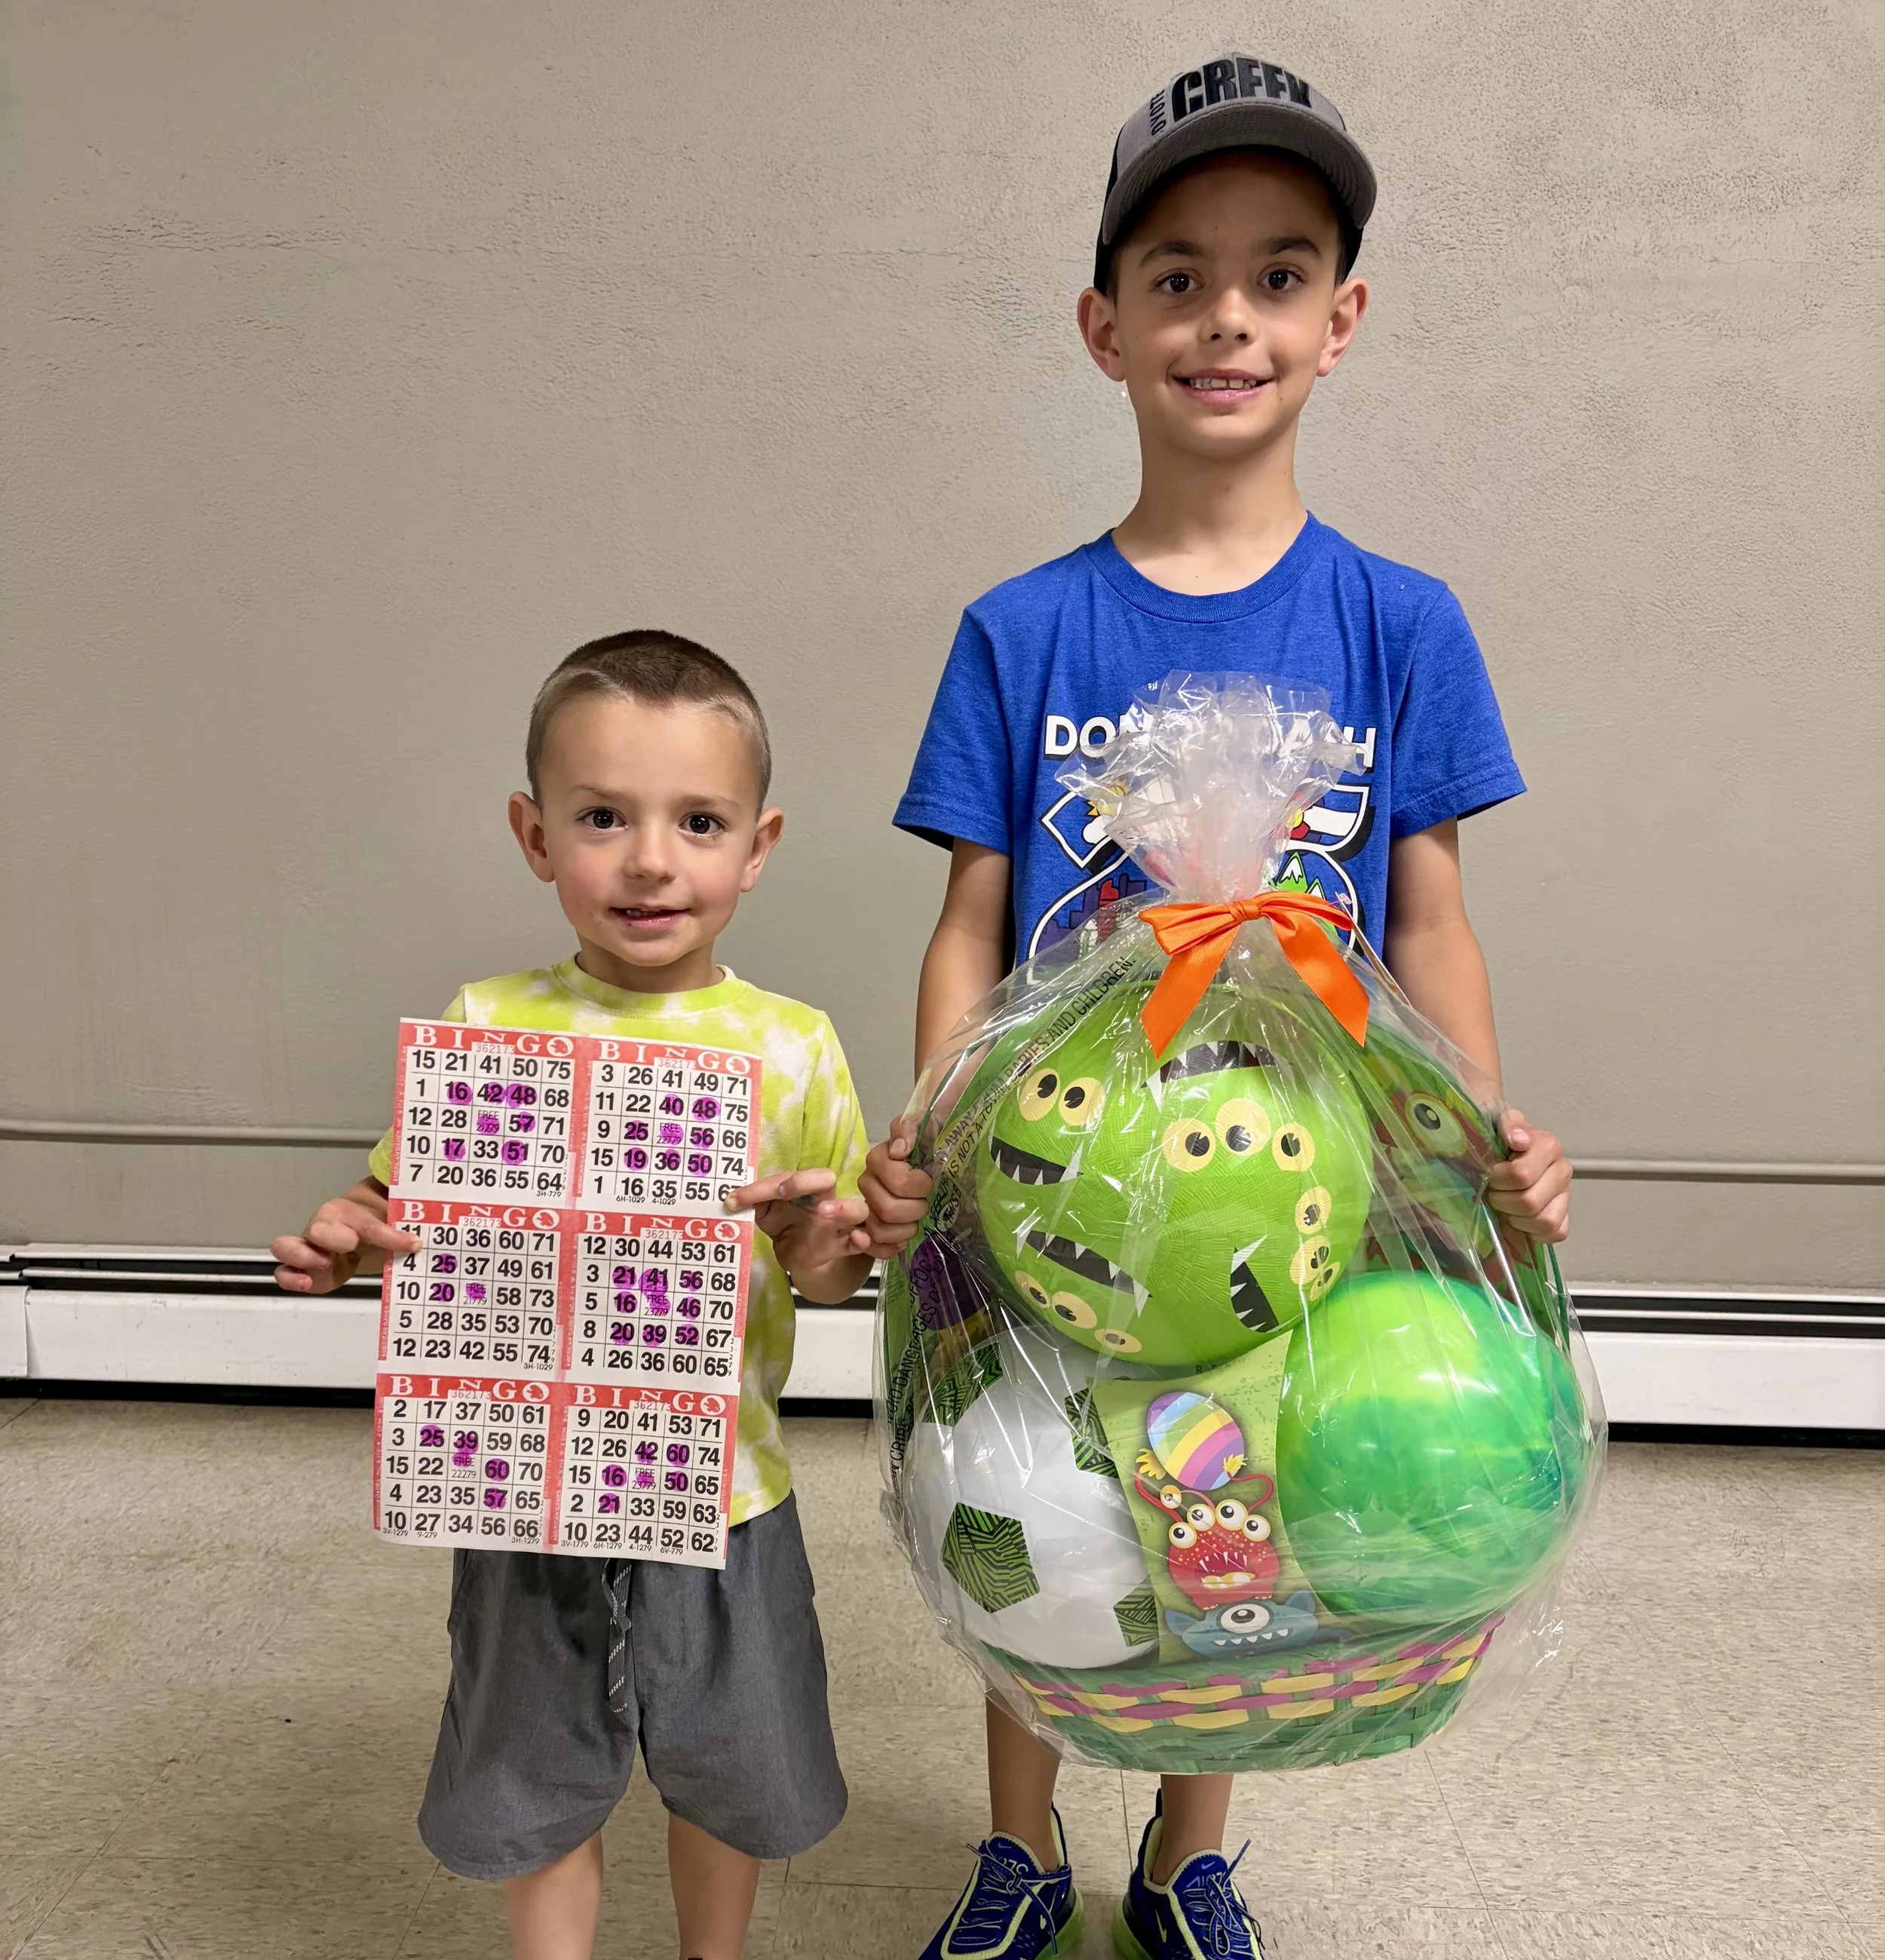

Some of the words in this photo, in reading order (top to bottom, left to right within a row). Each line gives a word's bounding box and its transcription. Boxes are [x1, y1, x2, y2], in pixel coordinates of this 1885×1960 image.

[1047, 1012, 1076, 1042] AND
[413, 1025, 574, 1056] BINGO
[413, 1050, 435, 1069] 15
[446, 1052, 467, 1071] 21
[480, 1055, 501, 1073] 41
[513, 1058, 537, 1076] 50
[547, 1061, 570, 1079] 75
[599, 1040, 750, 1075] BINGO
[417, 1079, 425, 1096] 1
[446, 1082, 467, 1100] 16
[477, 1084, 502, 1102] 42
[511, 1086, 536, 1104] 48
[544, 1089, 569, 1107] 68
[602, 1064, 613, 1082] 3
[628, 1067, 652, 1085] 26
[662, 1070, 682, 1088] 41
[694, 1073, 718, 1092] 49
[726, 1076, 747, 1096] 71
[477, 1110, 499, 1121] FREE
[596, 1092, 614, 1110] 11
[626, 1095, 651, 1113] 22
[659, 1098, 683, 1116] 40
[692, 1100, 715, 1117] 48
[725, 1103, 748, 1122] 75
[409, 1107, 431, 1125] 12
[441, 1110, 467, 1128] 28
[509, 1114, 535, 1132] 57
[543, 1117, 564, 1135] 71
[660, 1122, 681, 1133] FREE
[598, 1120, 610, 1138] 9
[624, 1122, 648, 1141] 25
[690, 1127, 714, 1145] 56
[722, 1129, 746, 1149] 66
[948, 1159, 960, 1178] IS
[958, 1131, 976, 1163] NOT
[975, 1122, 983, 1137] A
[410, 1164, 423, 1181] 7
[437, 1165, 463, 1185] 20
[472, 1168, 496, 1187] 36
[504, 1171, 529, 1189] 55
[538, 1172, 562, 1190] 64
[594, 1176, 602, 1193] 1
[621, 1178, 643, 1196] 16
[652, 1180, 676, 1198] 35
[685, 1182, 710, 1200] 55
[536, 1190, 562, 1199] 3H-779
[616, 1195, 646, 1205] 6H-1029
[651, 1197, 676, 1206] 4-1029
[402, 1201, 560, 1230] BINGO
[463, 1217, 501, 1229] 362173
[584, 1212, 740, 1242] BINGO
[433, 1227, 458, 1245] 30
[466, 1229, 490, 1248] 36
[499, 1231, 524, 1250] 60
[533, 1233, 553, 1251] 71
[645, 1230, 683, 1240] 362173
[584, 1236, 606, 1254] 12
[615, 1238, 639, 1257] 30
[648, 1240, 673, 1259] 44
[682, 1242, 705, 1261] 53
[714, 1244, 734, 1263] 61
[587, 1264, 599, 1282] 3
[614, 1266, 635, 1285] 21
[647, 1268, 668, 1286] 41
[679, 1270, 703, 1289] 56
[711, 1272, 735, 1291] 68
[397, 1282, 420, 1300] 10
[429, 1283, 455, 1302] 20
[496, 1287, 521, 1306] 58
[530, 1289, 554, 1307] 73
[585, 1292, 597, 1310] 5
[614, 1294, 636, 1313] 16
[676, 1298, 700, 1318] 46
[710, 1301, 733, 1319] 70
[646, 1294, 668, 1304] FREE
[394, 1338, 416, 1357] 12
[425, 1340, 450, 1358] 23
[459, 1341, 484, 1360] 42
[493, 1343, 517, 1361] 55
[528, 1345, 550, 1363] 74
[581, 1348, 594, 1366] 4
[608, 1349, 633, 1369] 26
[641, 1352, 664, 1371] 36
[673, 1354, 697, 1374] 60
[704, 1357, 728, 1377] 65
[523, 1362, 553, 1371] 3H-1029
[390, 1376, 550, 1402] BINGO
[574, 1385, 726, 1416] BINGO
[394, 1399, 406, 1417] 2
[424, 1401, 446, 1419] 17
[455, 1402, 481, 1420] 37
[489, 1404, 514, 1423] 50
[523, 1405, 544, 1423] 61
[578, 1409, 590, 1426] 9
[604, 1410, 629, 1429] 20
[637, 1413, 657, 1432] 41
[669, 1416, 692, 1435] 53
[700, 1419, 720, 1438] 71
[572, 1437, 593, 1455] 12
[602, 1438, 627, 1458] 26
[635, 1441, 658, 1460] 42
[667, 1444, 689, 1463] 60
[698, 1447, 720, 1465] 74
[387, 1456, 409, 1475] 15
[418, 1457, 443, 1475] 22
[486, 1460, 510, 1478] 60
[521, 1462, 542, 1481] 70
[452, 1470, 477, 1480] 22279
[569, 1465, 591, 1484] 15
[602, 1467, 624, 1486] 16
[664, 1472, 688, 1491] 50
[695, 1475, 719, 1495] 65
[635, 1467, 655, 1477] FREE
[385, 1511, 406, 1530] 10
[415, 1514, 440, 1531] 27
[449, 1515, 473, 1533] 34
[481, 1517, 505, 1536] 56
[514, 1519, 538, 1538] 66
[417, 1530, 438, 1539] 9-279
[565, 1522, 587, 1541] 10
[596, 1524, 620, 1542] 23
[629, 1526, 653, 1544] 44
[661, 1529, 684, 1548] 52
[691, 1532, 714, 1552] 62
[511, 1536, 540, 1545] 3H-1279
[561, 1540, 589, 1548] 3V-1779
[629, 1544, 652, 1552] 4-1279
[660, 1547, 683, 1555] 6V-779
